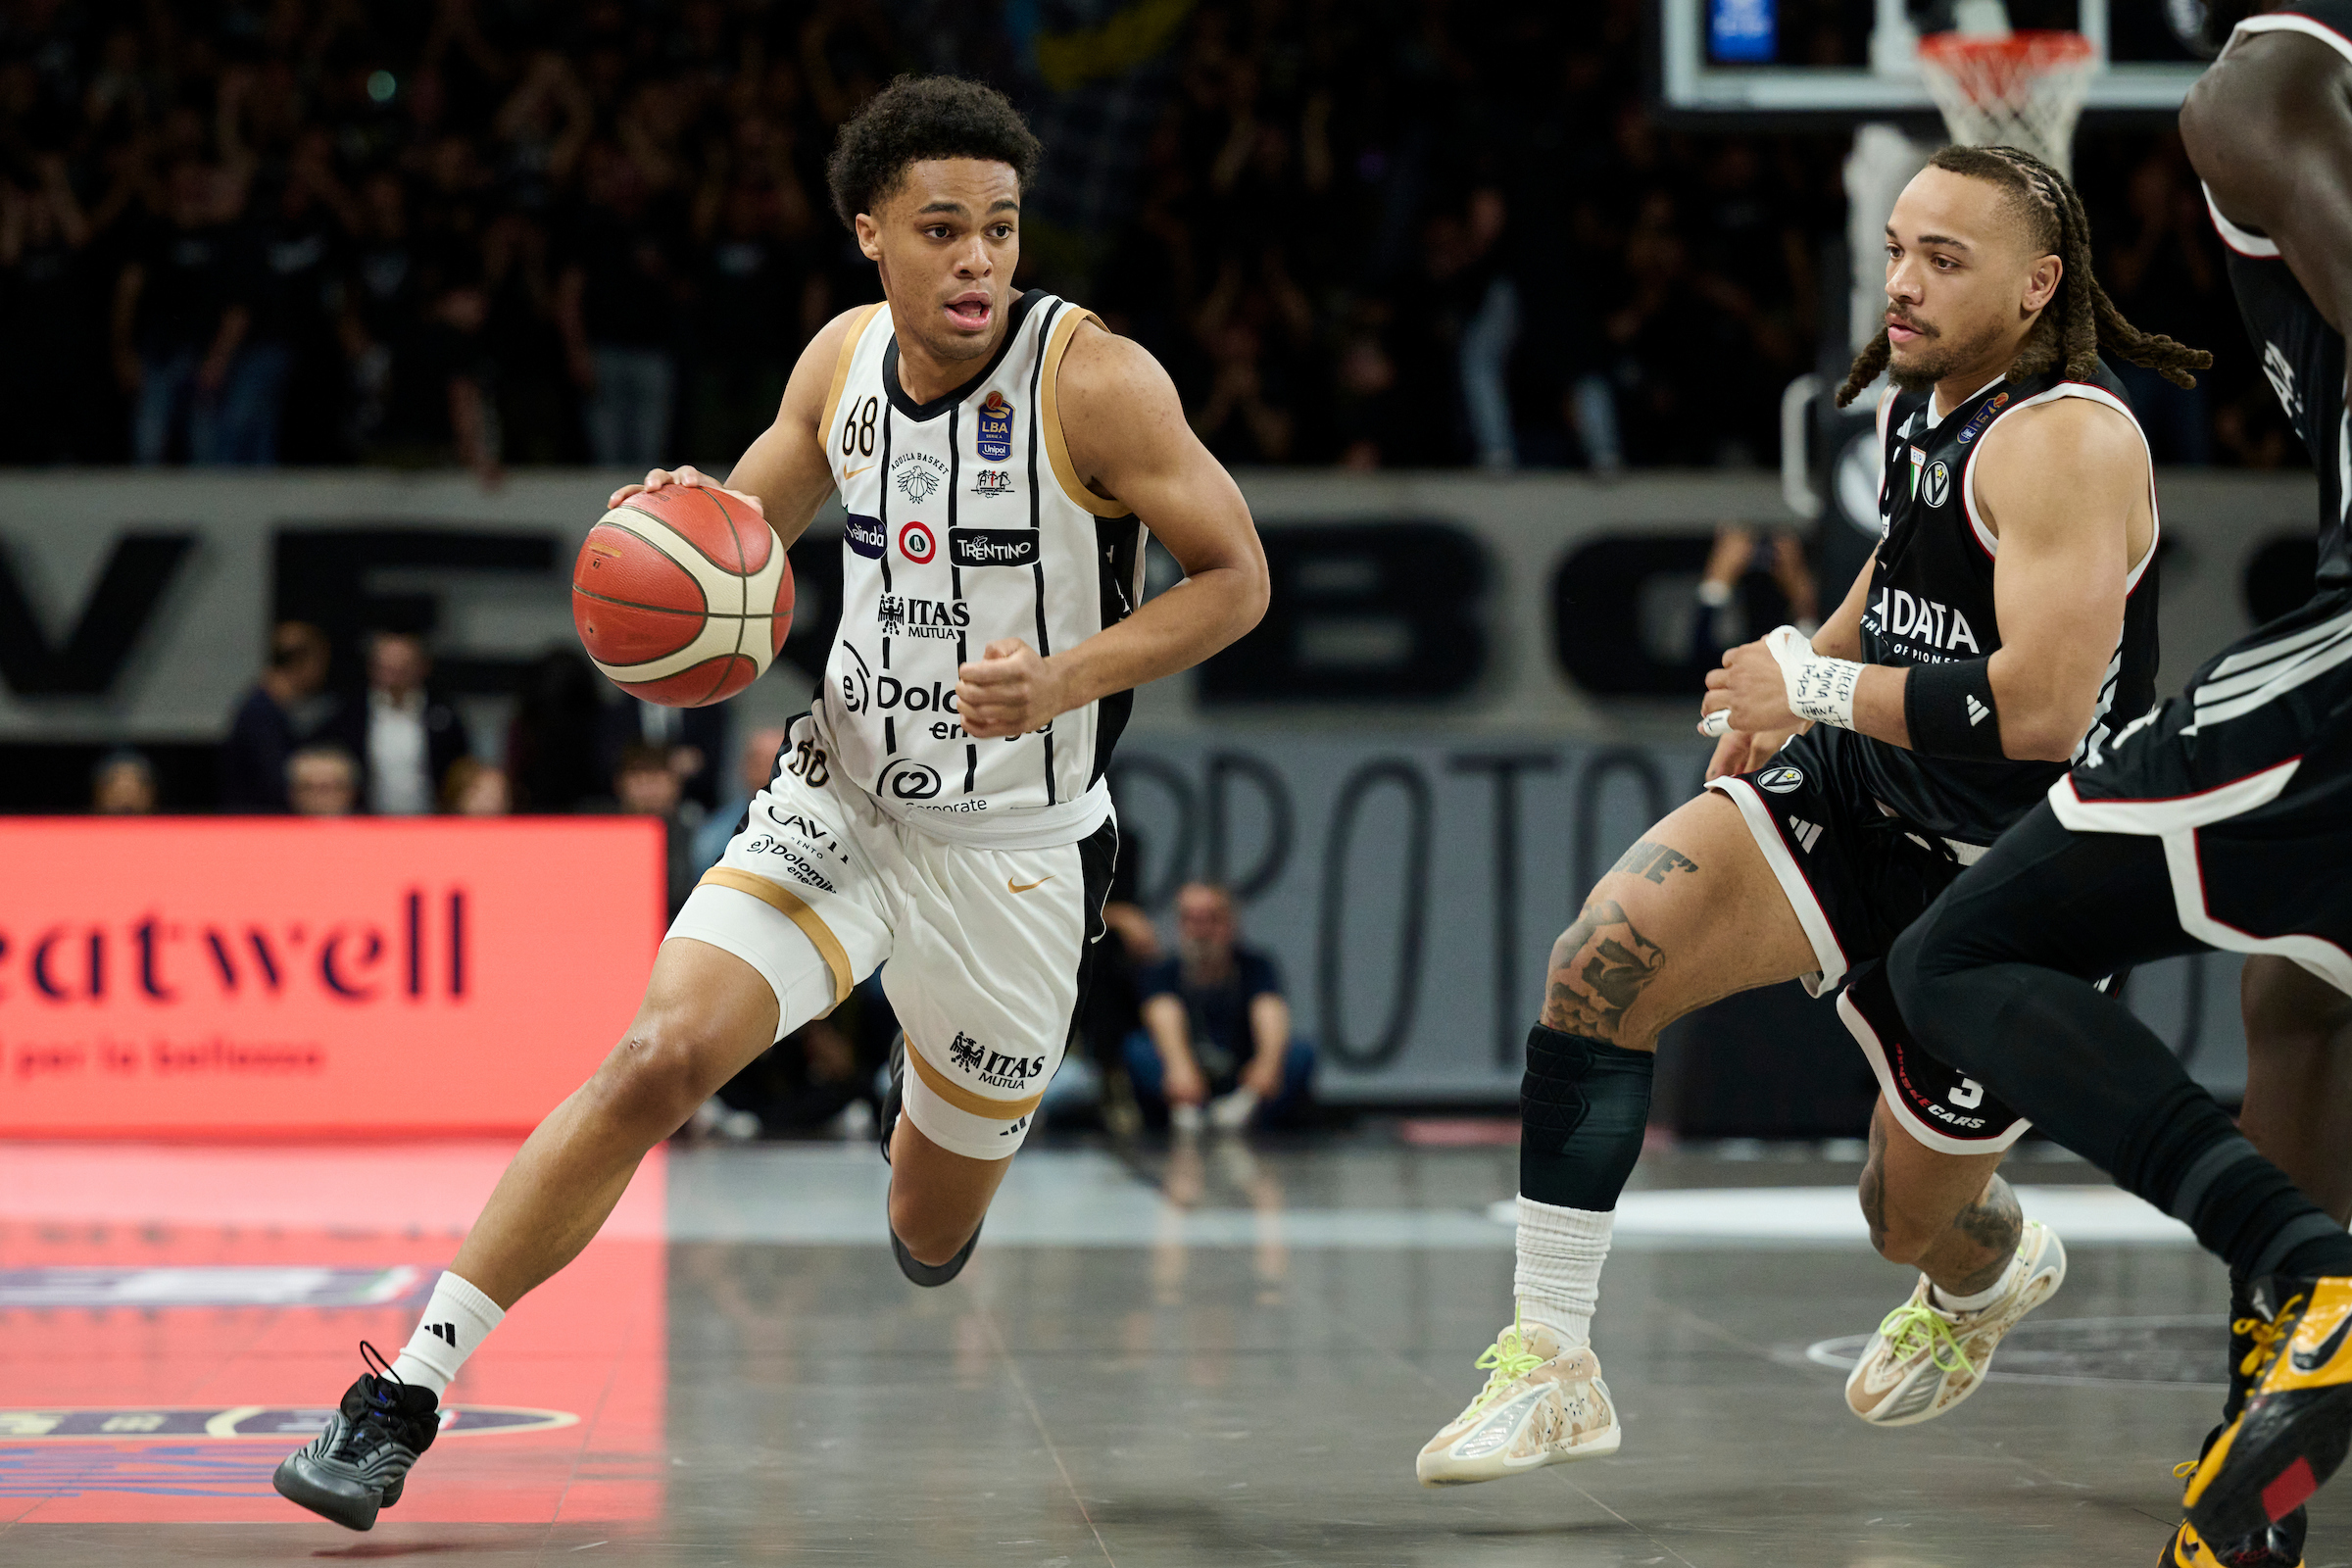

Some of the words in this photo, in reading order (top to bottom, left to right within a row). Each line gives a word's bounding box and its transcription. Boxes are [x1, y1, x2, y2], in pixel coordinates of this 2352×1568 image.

[842, 394, 879, 458] 68
[982, 420, 1008, 434] LBA
[984, 444, 1006, 456] Unipol
[917, 452, 950, 475] BASKET
[956, 539, 1032, 562] TRENTINO
[907, 598, 971, 627] ITAS
[907, 626, 956, 640] MUTUA
[1893, 643, 1909, 657] OF
[0, 886, 468, 1001] atwell
[983, 1050, 1046, 1079] ITAS
[978, 1071, 1025, 1090] MUTUA
